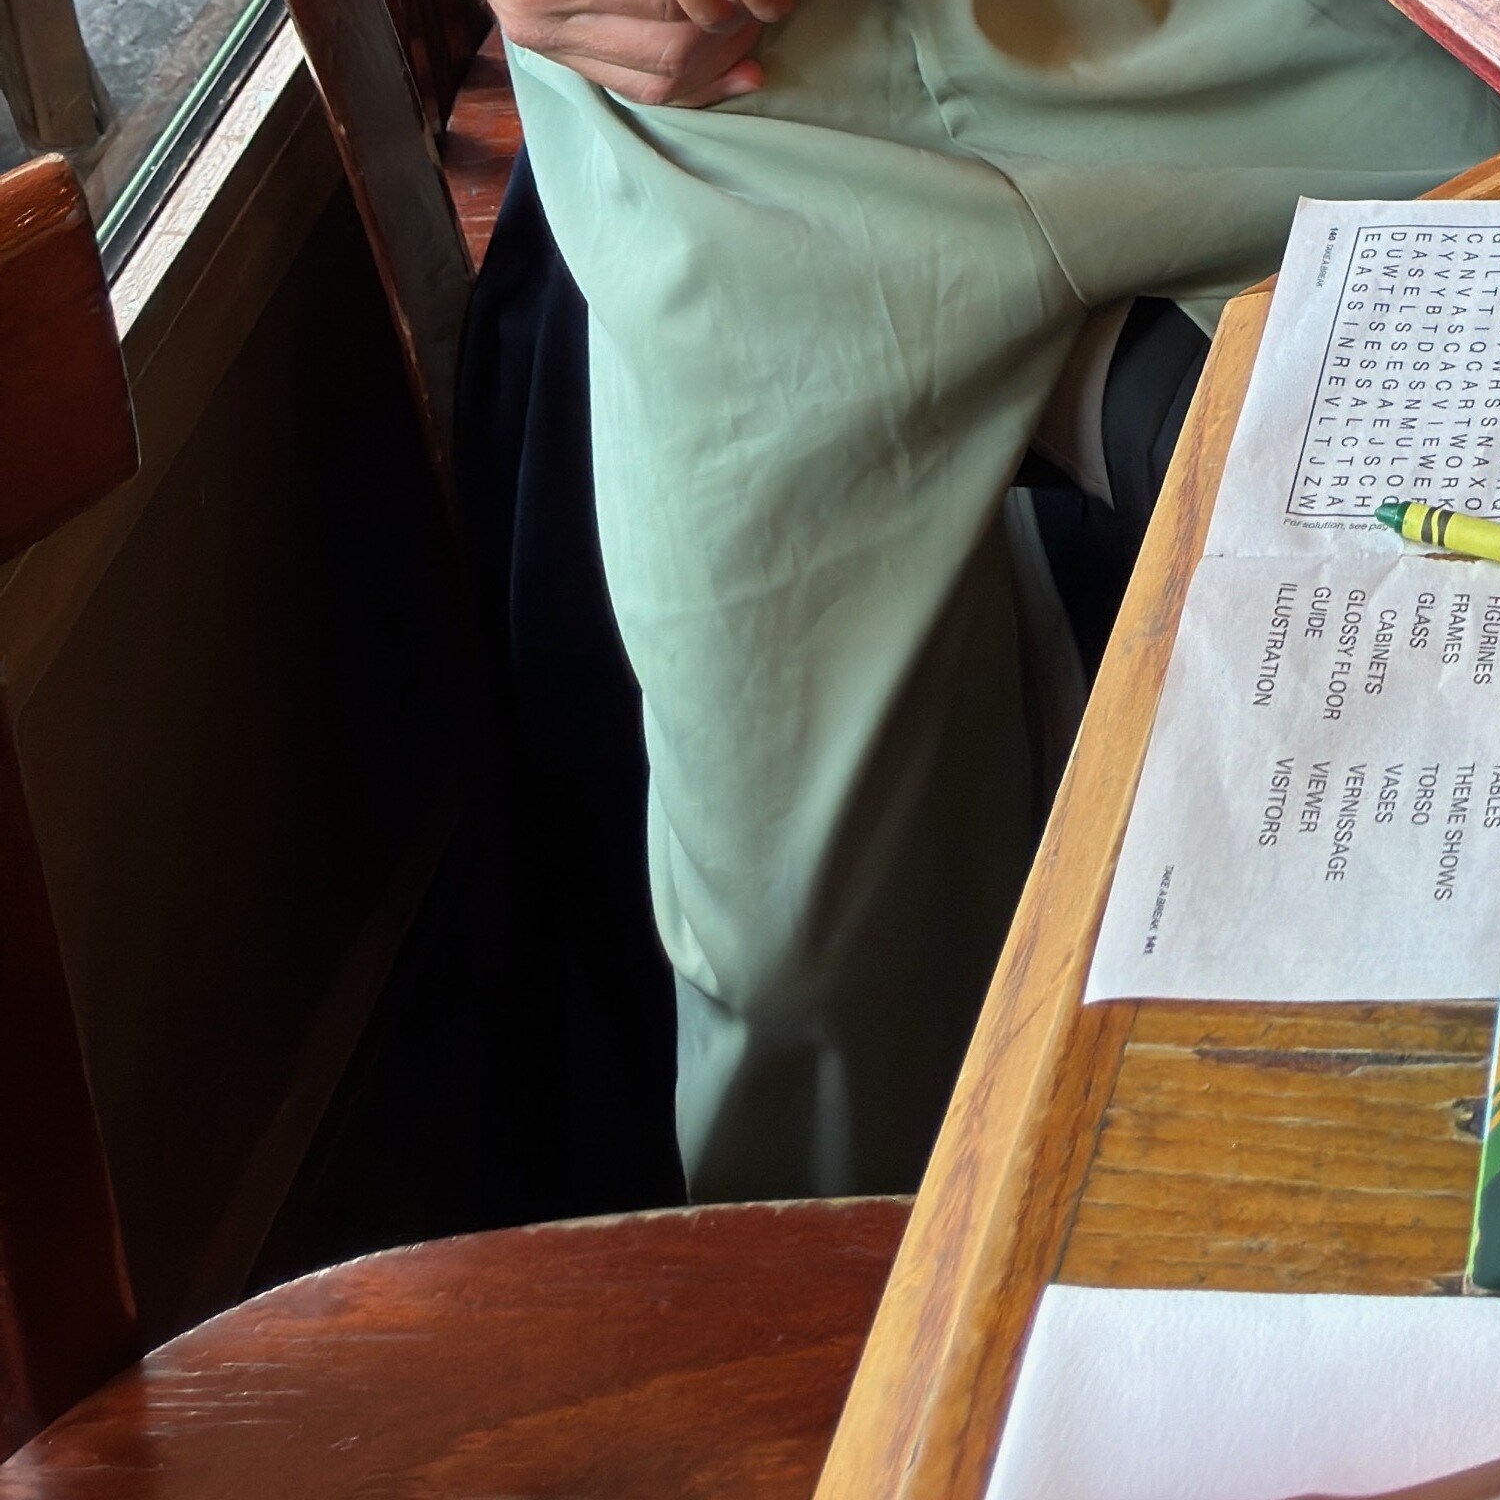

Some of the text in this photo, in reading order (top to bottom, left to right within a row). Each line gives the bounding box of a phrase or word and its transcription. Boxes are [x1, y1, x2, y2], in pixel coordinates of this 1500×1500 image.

[1323, 244, 1334, 259] TAKE
[1328, 228, 1338, 241] 140
[1316, 266, 1327, 287] BREAK
[1283, 518, 1301, 527] For
[1302, 521, 1343, 531] solution,
[1345, 523, 1364, 532] see
[1304, 587, 1331, 638] GUIDE
[1410, 592, 1435, 648] GLASS
[1442, 594, 1470, 664] FRAMES
[1253, 582, 1298, 706] ILLUSTRATION
[1322, 589, 1366, 720] GLOSSY FLOOR
[1365, 610, 1397, 695] CABINETS
[1258, 758, 1295, 847] VISITORS
[1299, 761, 1331, 833] VIEWER
[1325, 764, 1367, 882] VERNISSAGE
[1375, 763, 1403, 823] VASES
[1411, 763, 1440, 825] TORSO
[1434, 763, 1475, 900] THEME SHOWS
[1160, 865, 1174, 889] TAKE
[1149, 897, 1166, 931] BREAK
